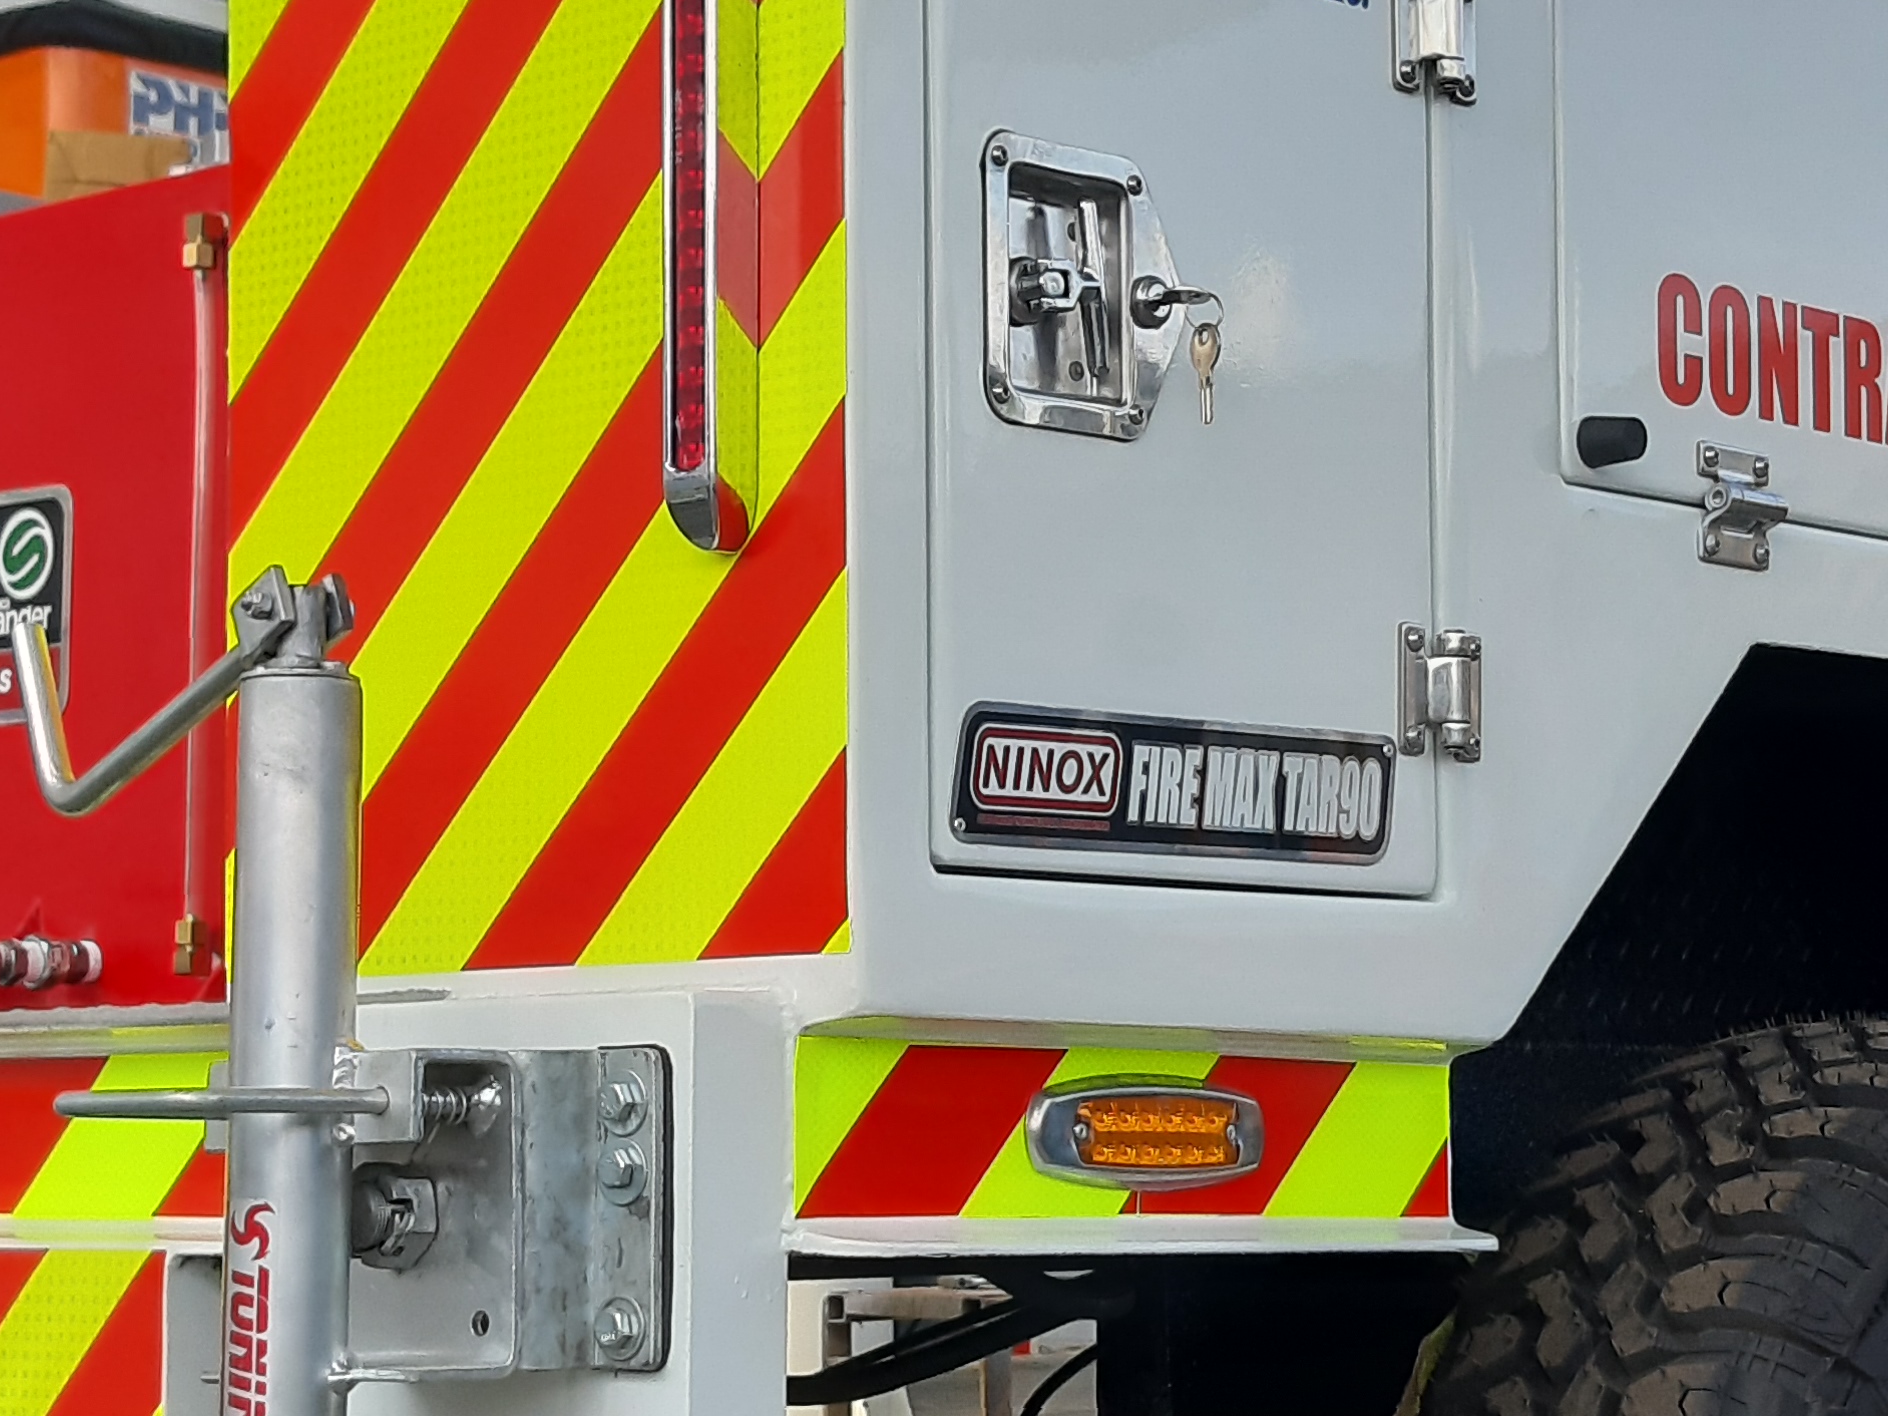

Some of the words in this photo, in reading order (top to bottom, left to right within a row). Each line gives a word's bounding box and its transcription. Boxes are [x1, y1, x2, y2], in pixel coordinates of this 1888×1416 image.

[982, 743, 1111, 798] NINOX
[1126, 742, 1204, 827] FIRE
[1201, 746, 1280, 833] MAX
